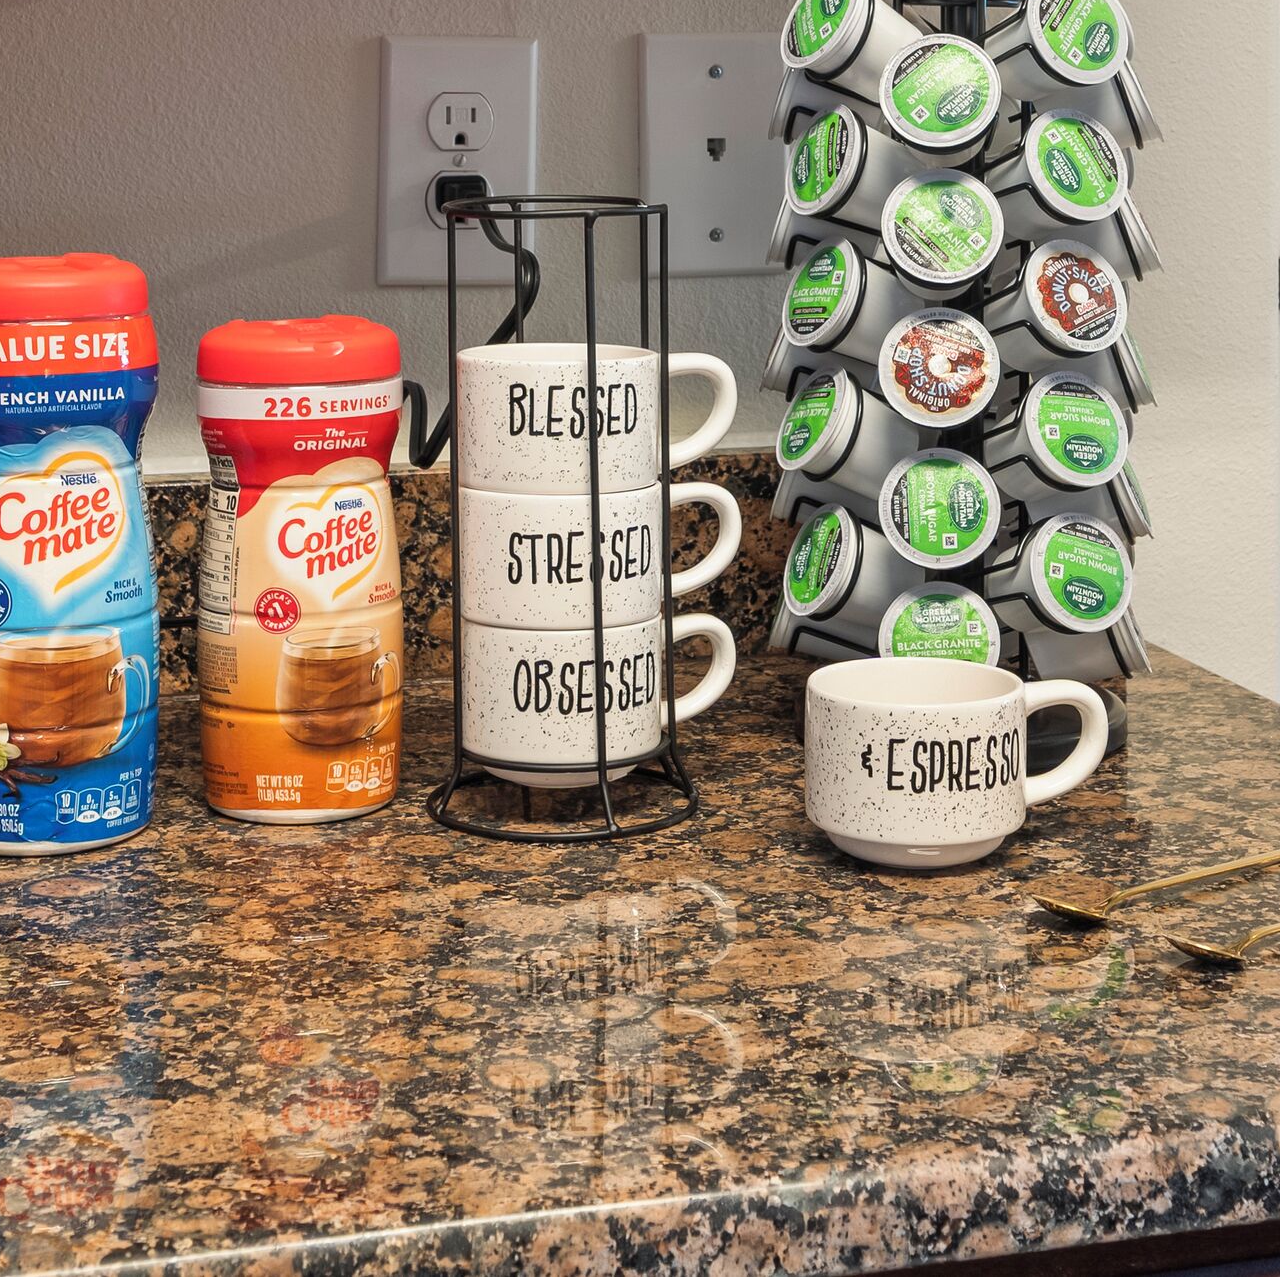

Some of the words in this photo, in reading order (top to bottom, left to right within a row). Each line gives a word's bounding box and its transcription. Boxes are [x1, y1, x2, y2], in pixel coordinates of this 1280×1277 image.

[1058, 16, 1084, 52] GRANITE
[1085, 22, 1108, 56] MOUNTAIN
[1093, 32, 1110, 56] GREEN
[898, 49, 924, 69] KEURIG
[904, 79, 936, 105] SUGAR
[936, 85, 976, 117] MOUNTAIN
[947, 95, 975, 117] GREEN
[1057, 123, 1088, 167] GRANITE
[1096, 134, 1114, 159] KEURIG
[1050, 158, 1070, 186] GREEN
[1051, 148, 1079, 189] MOUNTAIN
[1082, 165, 1107, 199] BLACK
[939, 193, 977, 227] MOUNTAIN
[950, 193, 976, 216] GREEN
[933, 220, 974, 257] GRANITE
[900, 242, 925, 264] KEURIG
[1045, 256, 1079, 278] ORIGINAL
[808, 286, 839, 297] GRANITE
[1052, 268, 1071, 313] DONUT
[1073, 266, 1103, 295] SHOP
[1075, 298, 1098, 315] DARK
[74, 332, 129, 359] SIZE
[908, 347, 928, 387] SHOP
[927, 364, 972, 397] DONUT
[1061, 382, 1085, 391] KEURIG
[55, 387, 125, 403] VANILLA
[908, 386, 951, 409] ORIGINAL
[5, 406, 33, 414] NATURAL
[81, 403, 102, 411] FLAVOR
[264, 397, 312, 417] 226
[509, 383, 637, 439] BLESSED
[808, 406, 830, 416] BLACK
[1048, 410, 1079, 421] SUGAR
[1063, 404, 1094, 415] CRUMBLE
[1080, 414, 1110, 426] BROWN
[325, 428, 345, 437] The
[294, 437, 367, 451] ORIGINAL
[1065, 442, 1102, 454] MOUNTAIN
[218, 458, 233, 468] Facts
[1072, 450, 1097, 459] GREEN
[925, 470, 935, 506] BROWN
[226, 495, 236, 511] 10
[957, 483, 967, 527] MOUNTAIN
[965, 490, 974, 520] GREEN
[278, 511, 373, 559] Coffee
[1075, 522, 1098, 535] KEURIG
[24, 513, 115, 565] mate
[306, 532, 376, 579] mate
[795, 544, 805, 571] GREEN
[798, 537, 811, 578] MOUNTAIN
[830, 542, 840, 569] KEURIG
[1057, 549, 1086, 566] SUGAR
[1073, 546, 1102, 561] CRUMBLE
[1087, 558, 1117, 575] BROWN
[105, 585, 143, 603] Smooth
[114, 579, 131, 590] RICH
[132, 578, 137, 586] &
[1066, 582, 1102, 601] MOUNTAIN
[258, 593, 292, 613] AMERICA'S
[368, 590, 396, 603] Smooth
[1072, 592, 1096, 606] GREEN
[268, 601, 283, 618] #1
[915, 614, 959, 623] MOUNTAIN
[922, 607, 951, 615] GREEN
[897, 641, 934, 651] BLACK
[934, 638, 980, 649] GRANITE
[513, 651, 655, 715] OBSESSED
[332, 765, 342, 777] 10
[887, 728, 1021, 794] ESPRESSO
[256, 775, 270, 787] NET
[271, 775, 283, 787] WT
[284, 775, 293, 787] 16
[293, 775, 303, 787] OZ
[0, 804, 7, 816] 30
[8, 804, 20, 816] OZ
[61, 793, 70, 807] 10
[107, 819, 122, 828] COFFEE
